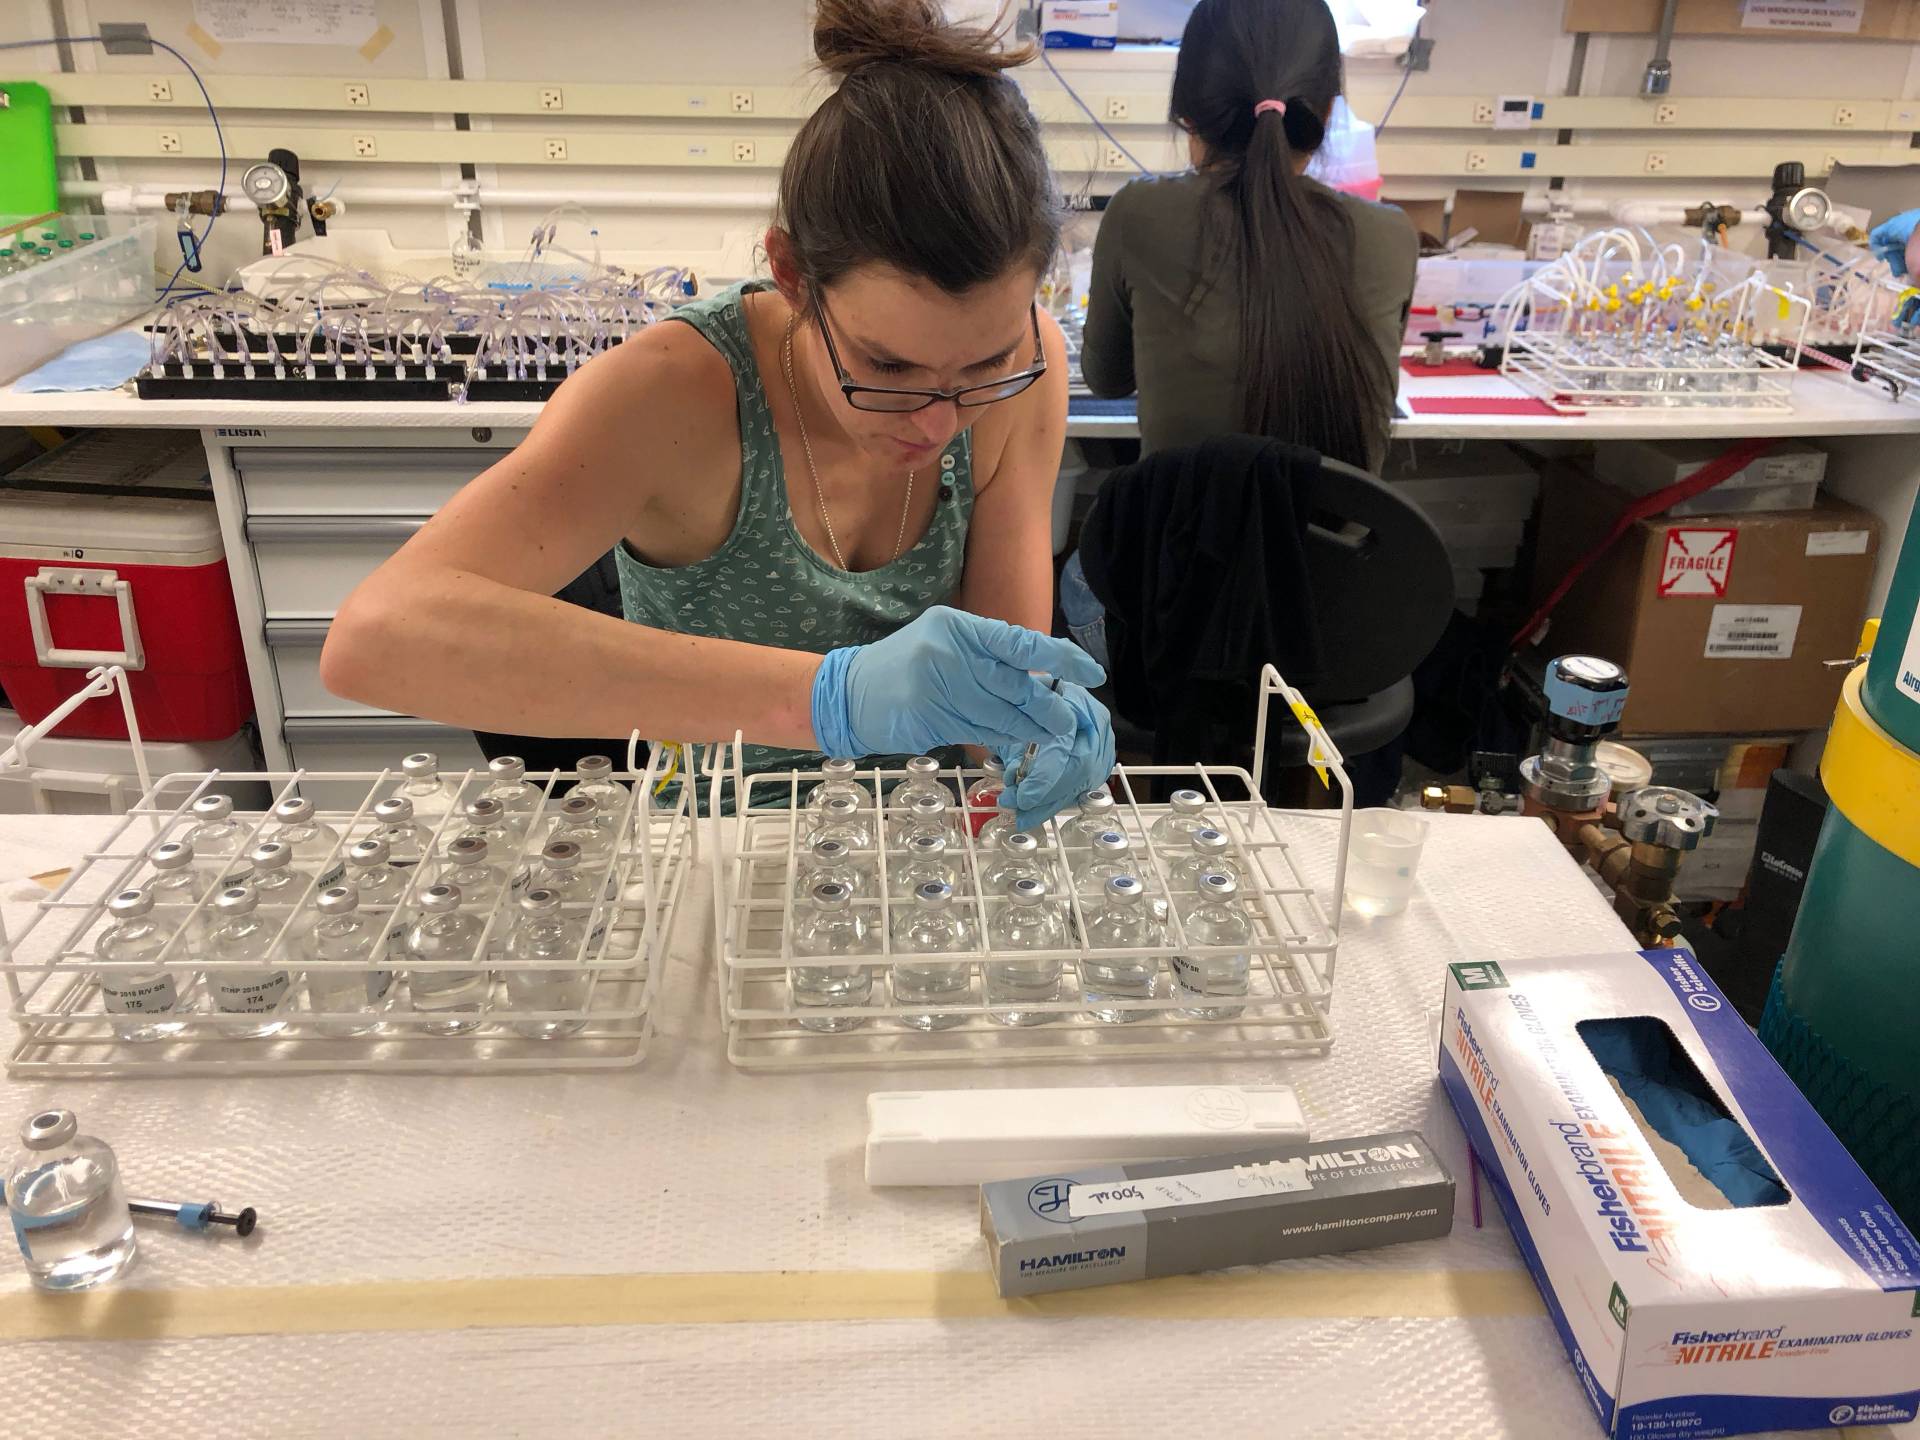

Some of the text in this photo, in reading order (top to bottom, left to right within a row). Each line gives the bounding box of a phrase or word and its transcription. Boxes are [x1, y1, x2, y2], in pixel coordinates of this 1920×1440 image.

[227, 429, 262, 437] LISTA
[1668, 555, 1725, 571] FRAGILE
[1903, 670, 1920, 693] Airg
[1669, 966, 1695, 993] Fisher
[1673, 954, 1708, 992] Scientific
[120, 990, 137, 998] 2018
[138, 987, 152, 996] R/V
[154, 983, 165, 991] SR
[243, 985, 260, 994] 2018
[246, 995, 264, 1005] 174
[125, 1000, 143, 1009] 175
[1457, 1007, 1500, 1091] Fisherbrand
[1456, 1030, 1494, 1113] NITRILE
[1493, 1099, 1529, 1173] EXAMINATION
[1528, 1169, 1551, 1217] GLOVES
[1233, 1143, 1421, 1175] MILTON
[1331, 1170, 1345, 1180] OF
[1350, 1161, 1420, 1177] EXCELLENCE
[1550, 1121, 1649, 1252] Fisherbrand
[1281, 1207, 1438, 1236] www.hamiltoncompany.com
[1860, 1210, 1908, 1271] Single Use Only
[1020, 1245, 1126, 1271] HAMILTON
[1671, 1325, 1784, 1346] Fisherbrand
[1675, 1328, 1913, 1366] NITRILE EXAMINATION GLOVES
[1855, 1409, 1910, 1421] Scientific
[1857, 1404, 1895, 1413] Fisher
